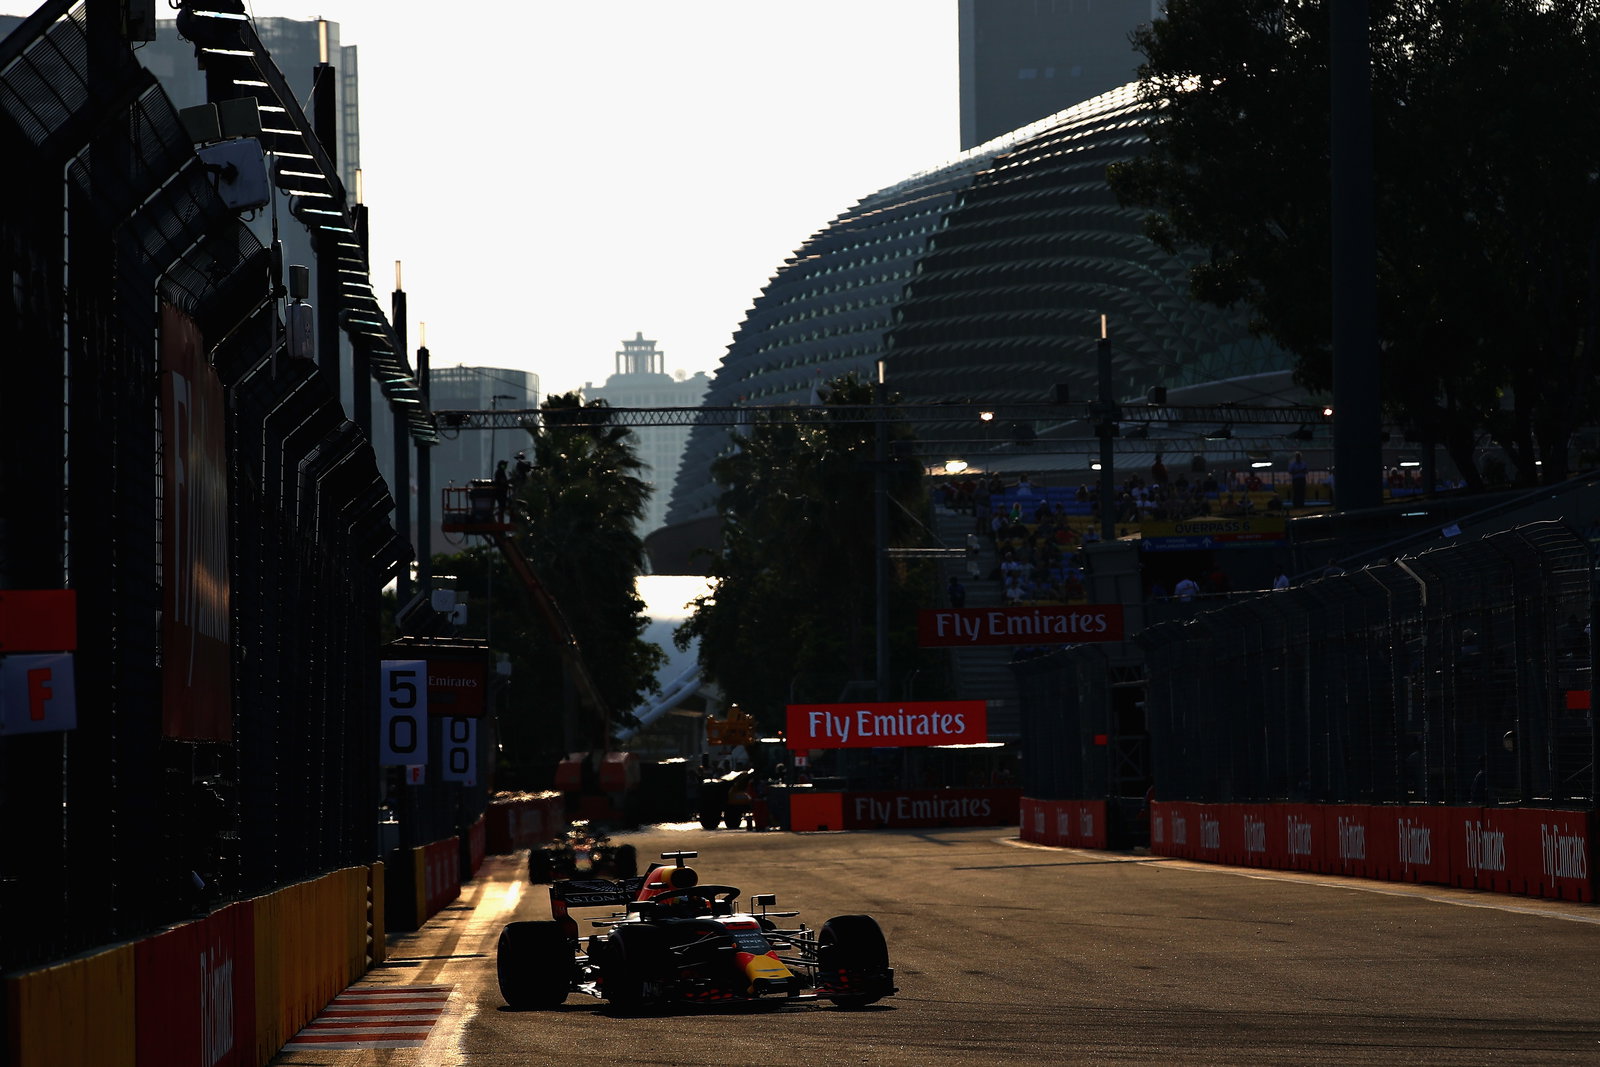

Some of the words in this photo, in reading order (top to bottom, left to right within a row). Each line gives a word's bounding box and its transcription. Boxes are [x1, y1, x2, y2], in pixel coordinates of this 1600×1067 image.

[1175, 521, 1240, 533] OVERPASS
[935, 612, 982, 642] Fly
[987, 609, 1107, 636] Emirates
[27, 667, 52, 721] F
[428, 675, 478, 688] Emirates
[389, 671, 416, 753] 50
[808, 711, 850, 743] Fly
[856, 708, 966, 737] Emirates
[854, 797, 891, 825] Fly
[896, 794, 991, 820] Emirates
[1541, 823, 1554, 888] Fly
[1553, 822, 1587, 879] Emirates
